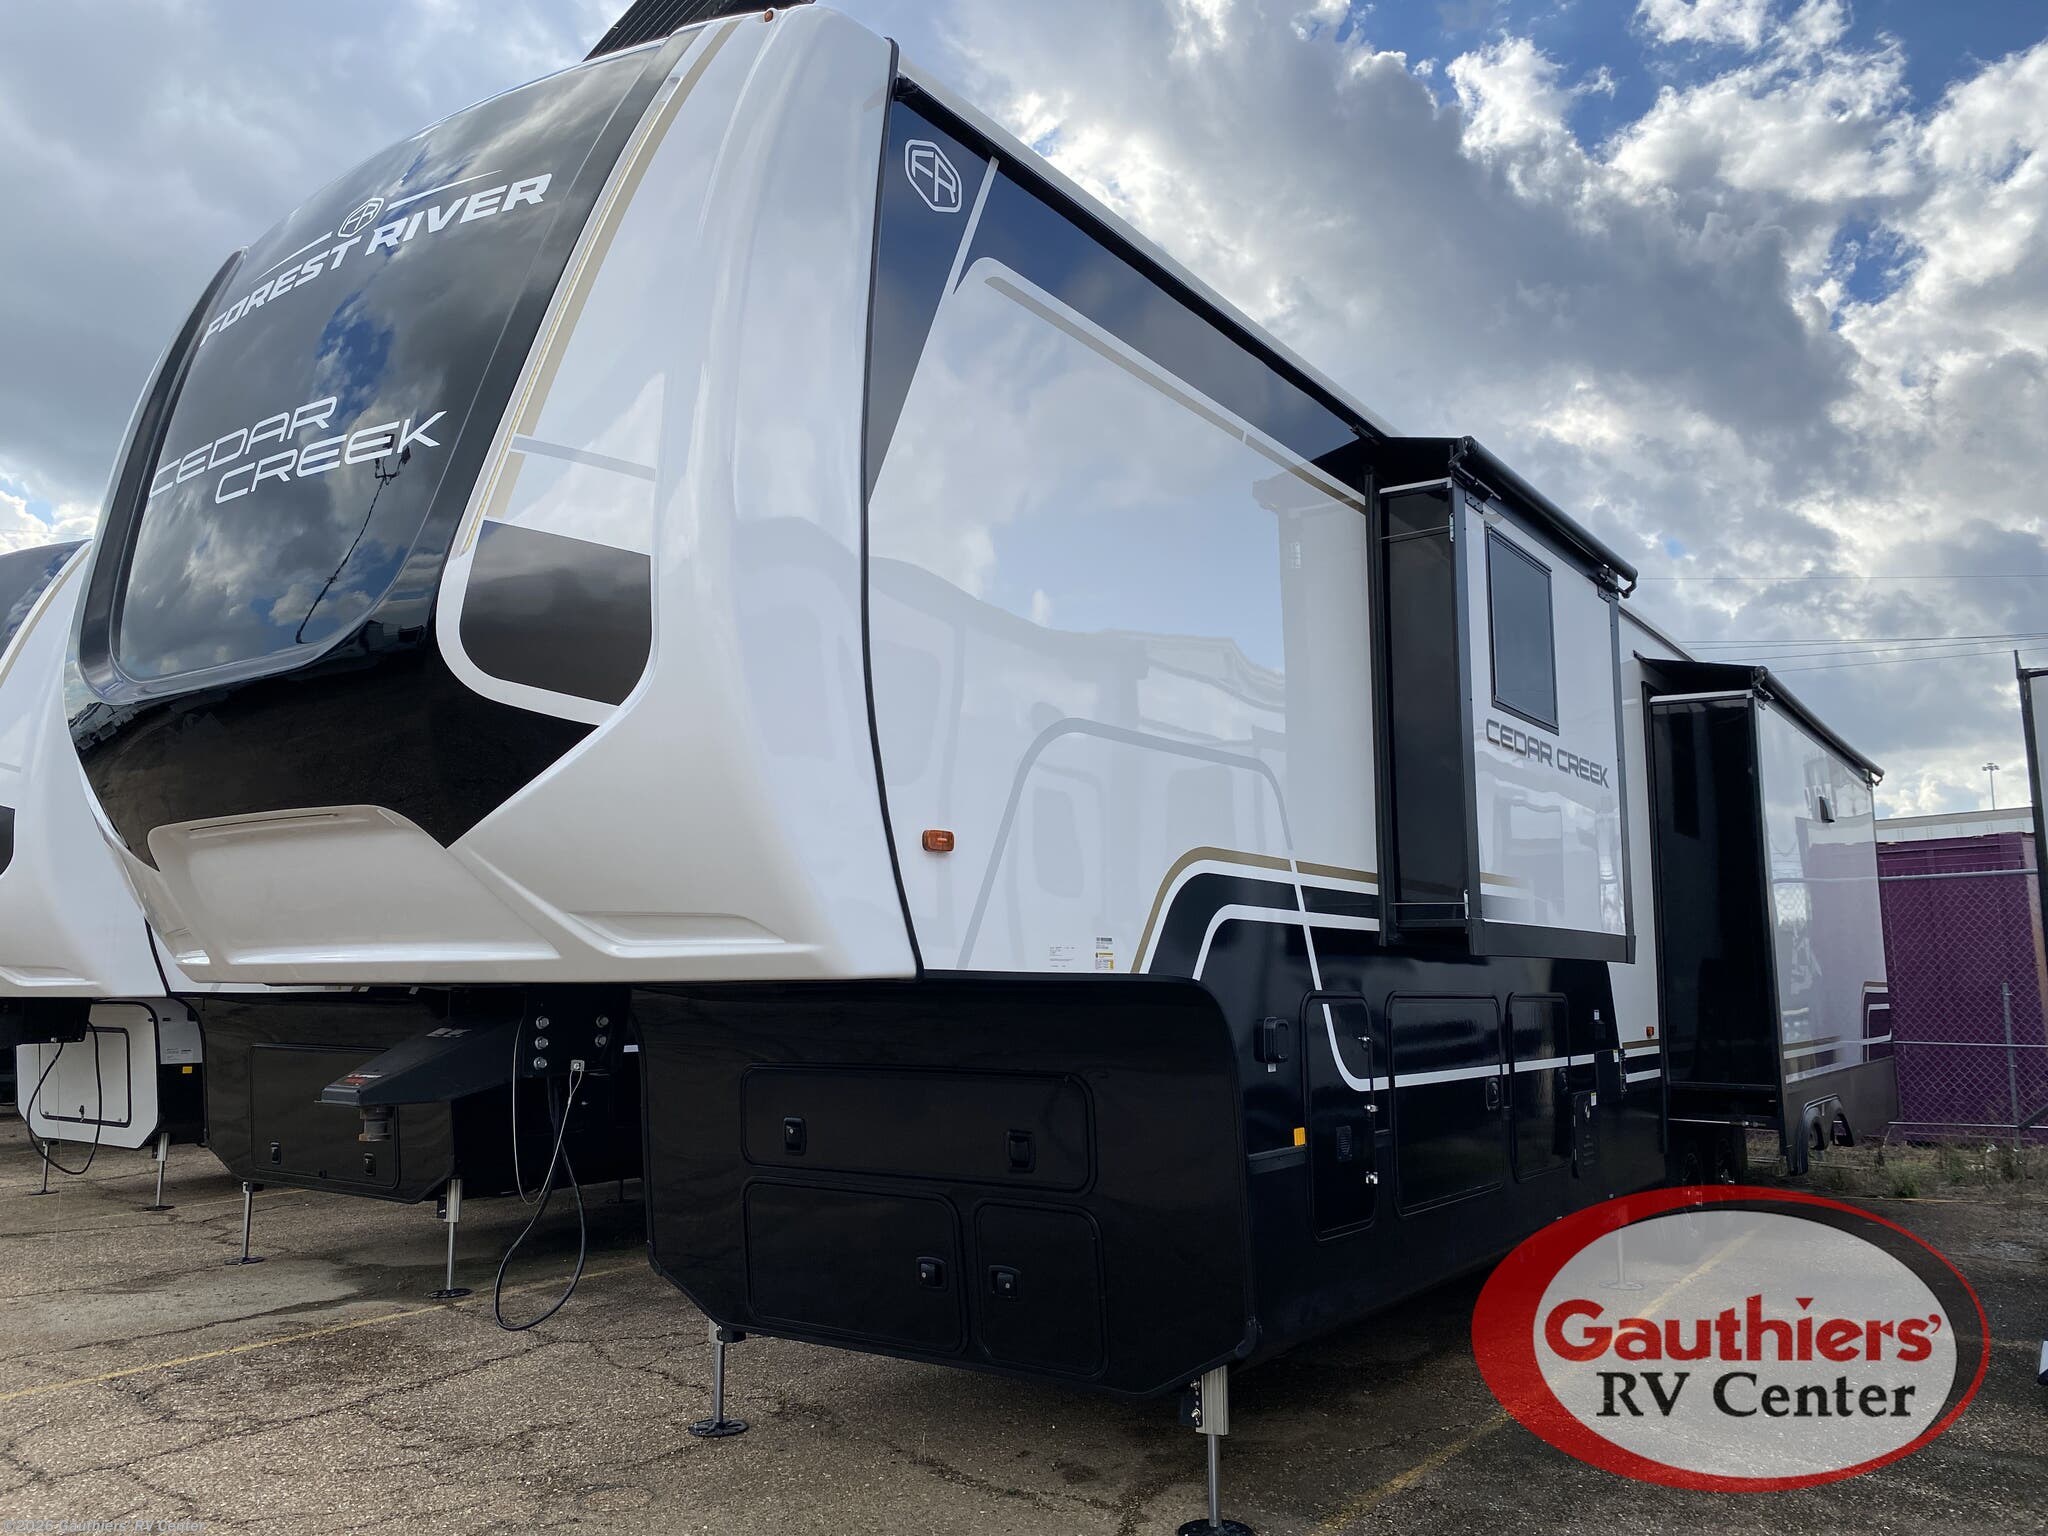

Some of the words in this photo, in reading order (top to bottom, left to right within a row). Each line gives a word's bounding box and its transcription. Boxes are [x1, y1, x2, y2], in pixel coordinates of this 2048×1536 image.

[200, 236, 362, 348] FOREST
[365, 173, 553, 256] RIVER
[149, 396, 338, 499] CEDAR
[215, 410, 447, 504] CREEK
[1487, 719, 1553, 767] CEDAR
[1557, 748, 1610, 789] CREEK
